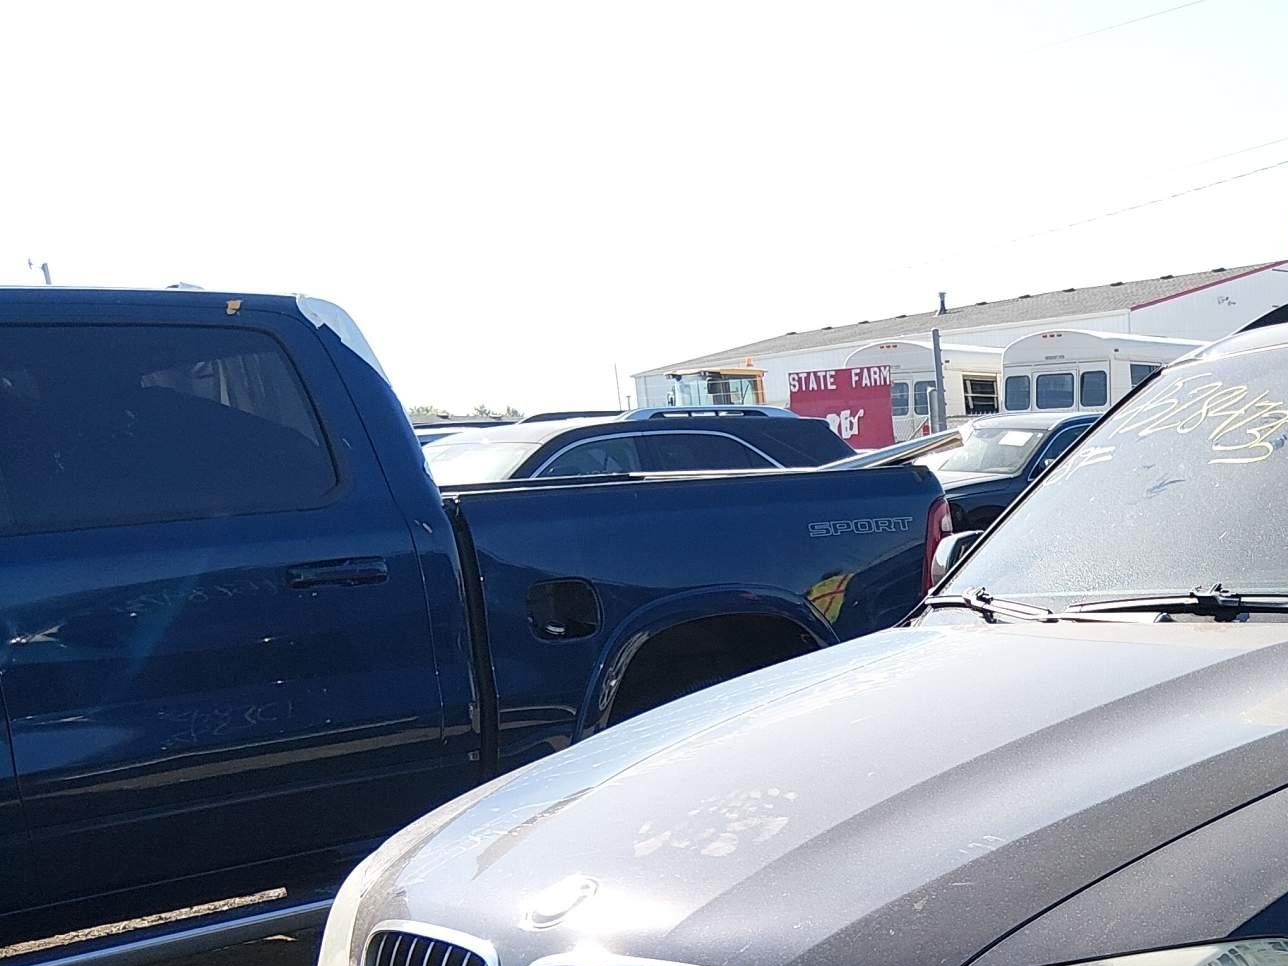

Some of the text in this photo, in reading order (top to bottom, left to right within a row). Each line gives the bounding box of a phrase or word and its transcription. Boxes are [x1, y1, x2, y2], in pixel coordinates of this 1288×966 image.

[789, 365, 890, 393] STATE FARM
[807, 516, 913, 538] SPORT
